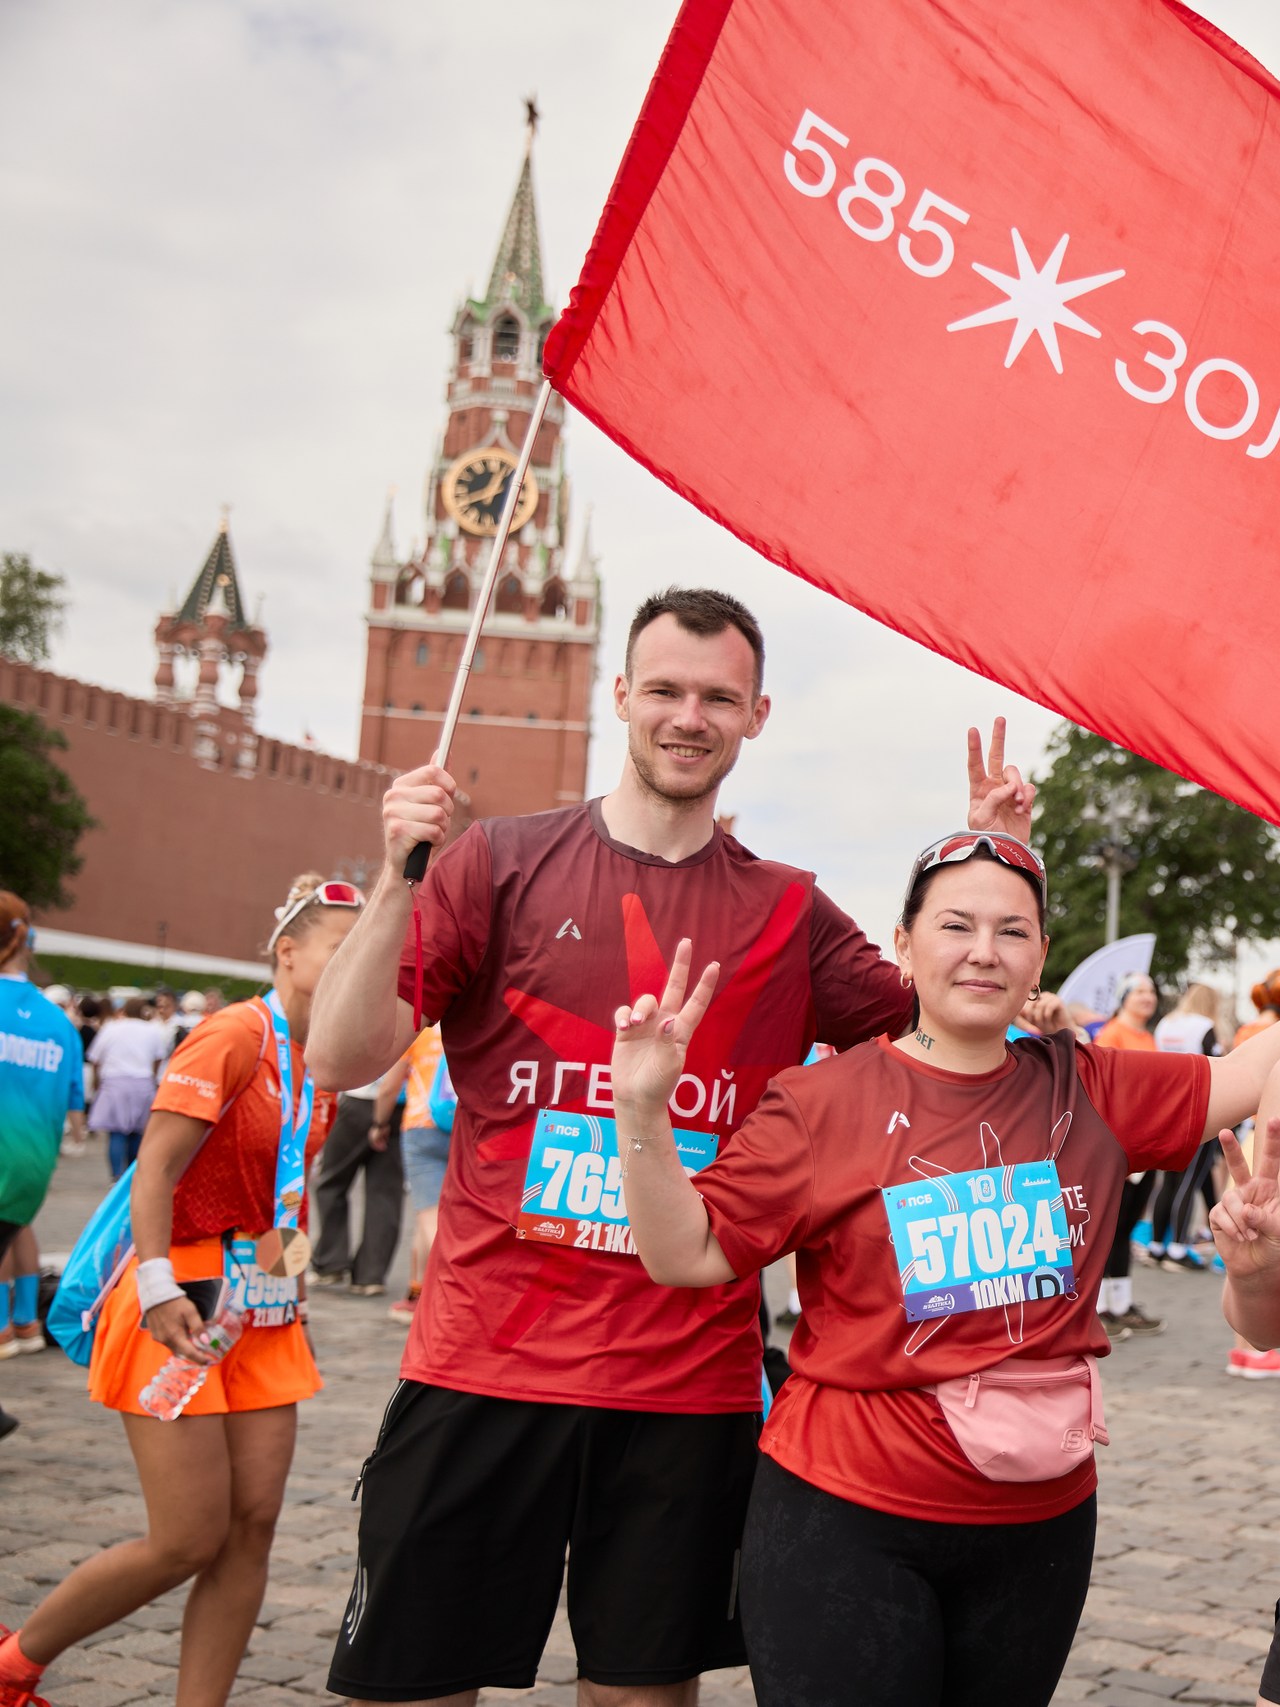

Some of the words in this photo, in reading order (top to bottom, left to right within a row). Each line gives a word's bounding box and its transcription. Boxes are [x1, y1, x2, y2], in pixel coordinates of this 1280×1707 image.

[783, 108, 970, 278] 585
[507, 1060, 539, 1104] Я
[551, 1061, 737, 1125] ГЕОЙ
[556, 1125, 580, 1137] ПСБ
[908, 1194, 932, 1207] ПСБ
[966, 1175, 996, 1204] 10
[906, 1199, 1060, 1284] 57024
[1035, 1274, 1060, 1300] D
